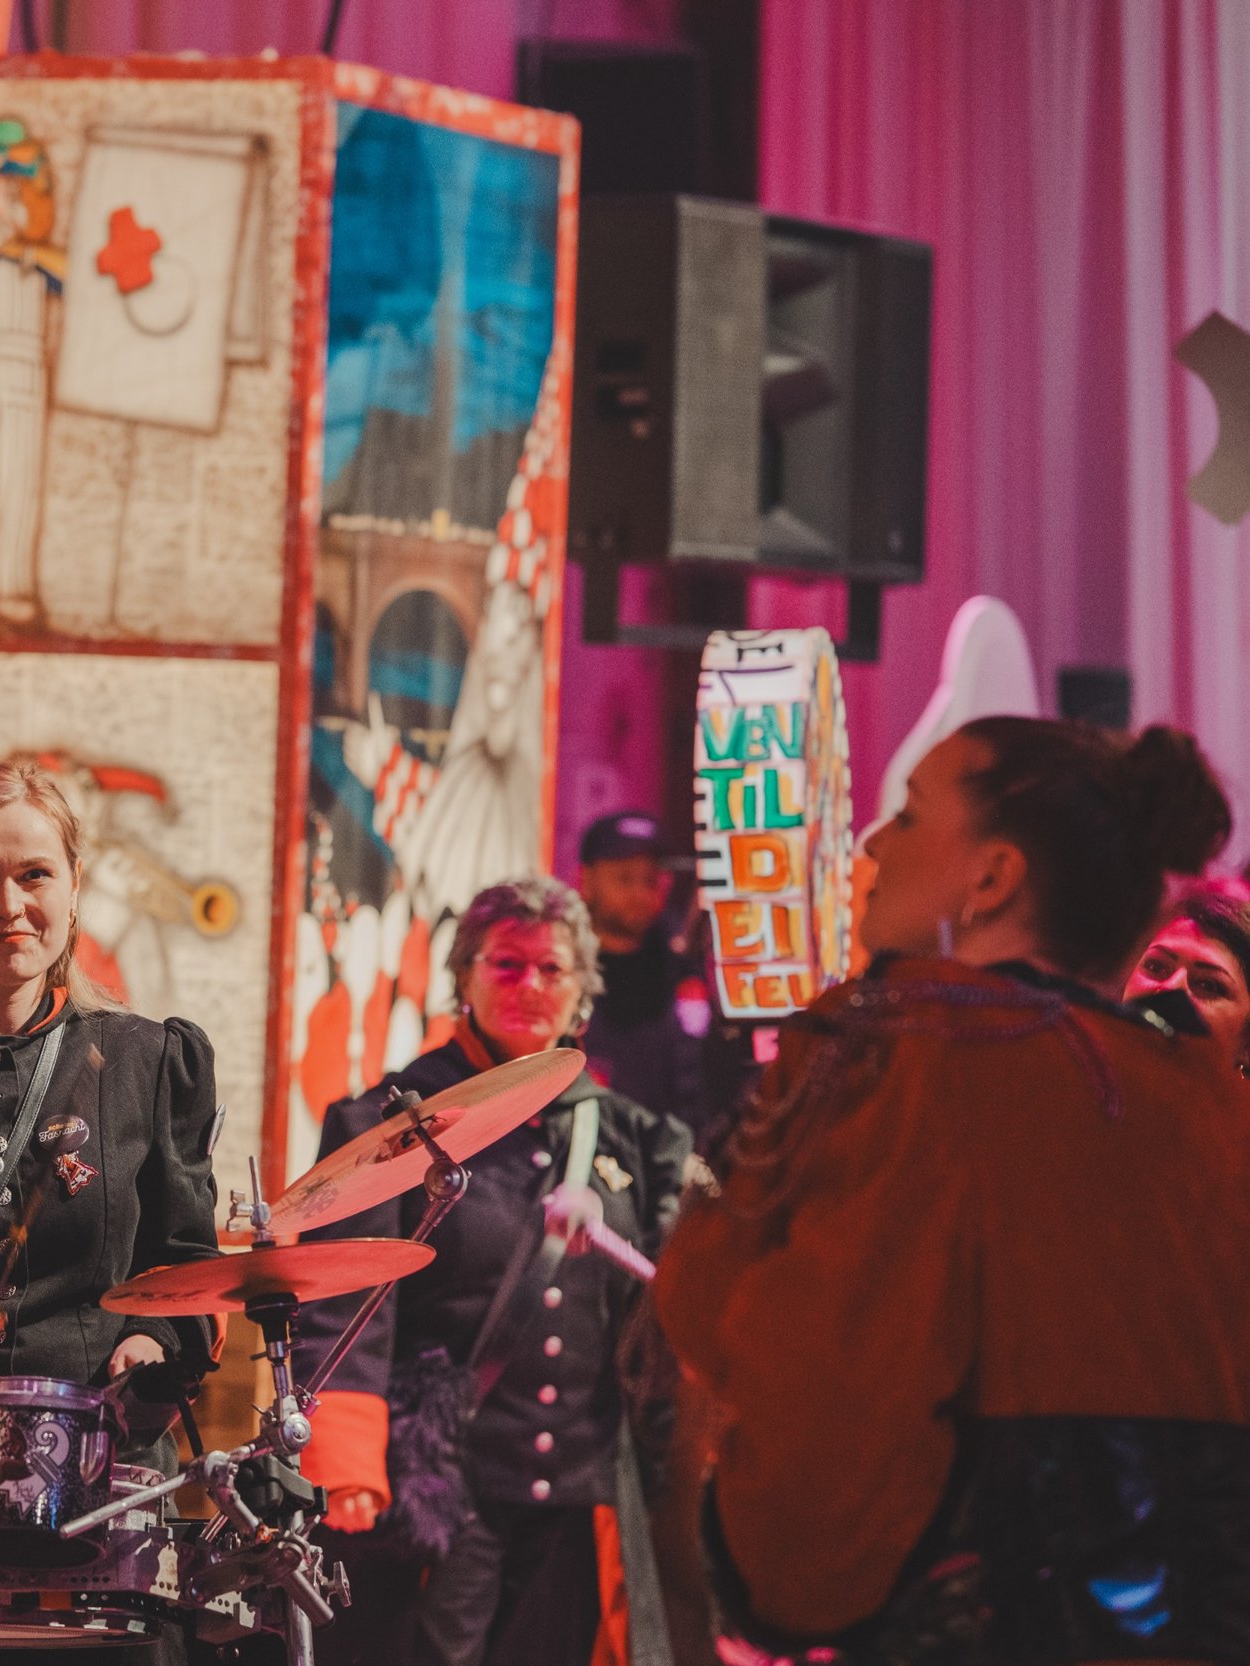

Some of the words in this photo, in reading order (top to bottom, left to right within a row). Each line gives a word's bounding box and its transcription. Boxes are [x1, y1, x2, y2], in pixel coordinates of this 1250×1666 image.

[701, 701, 804, 762] VEN
[730, 835, 790, 890] D
[715, 901, 792, 956] EI
